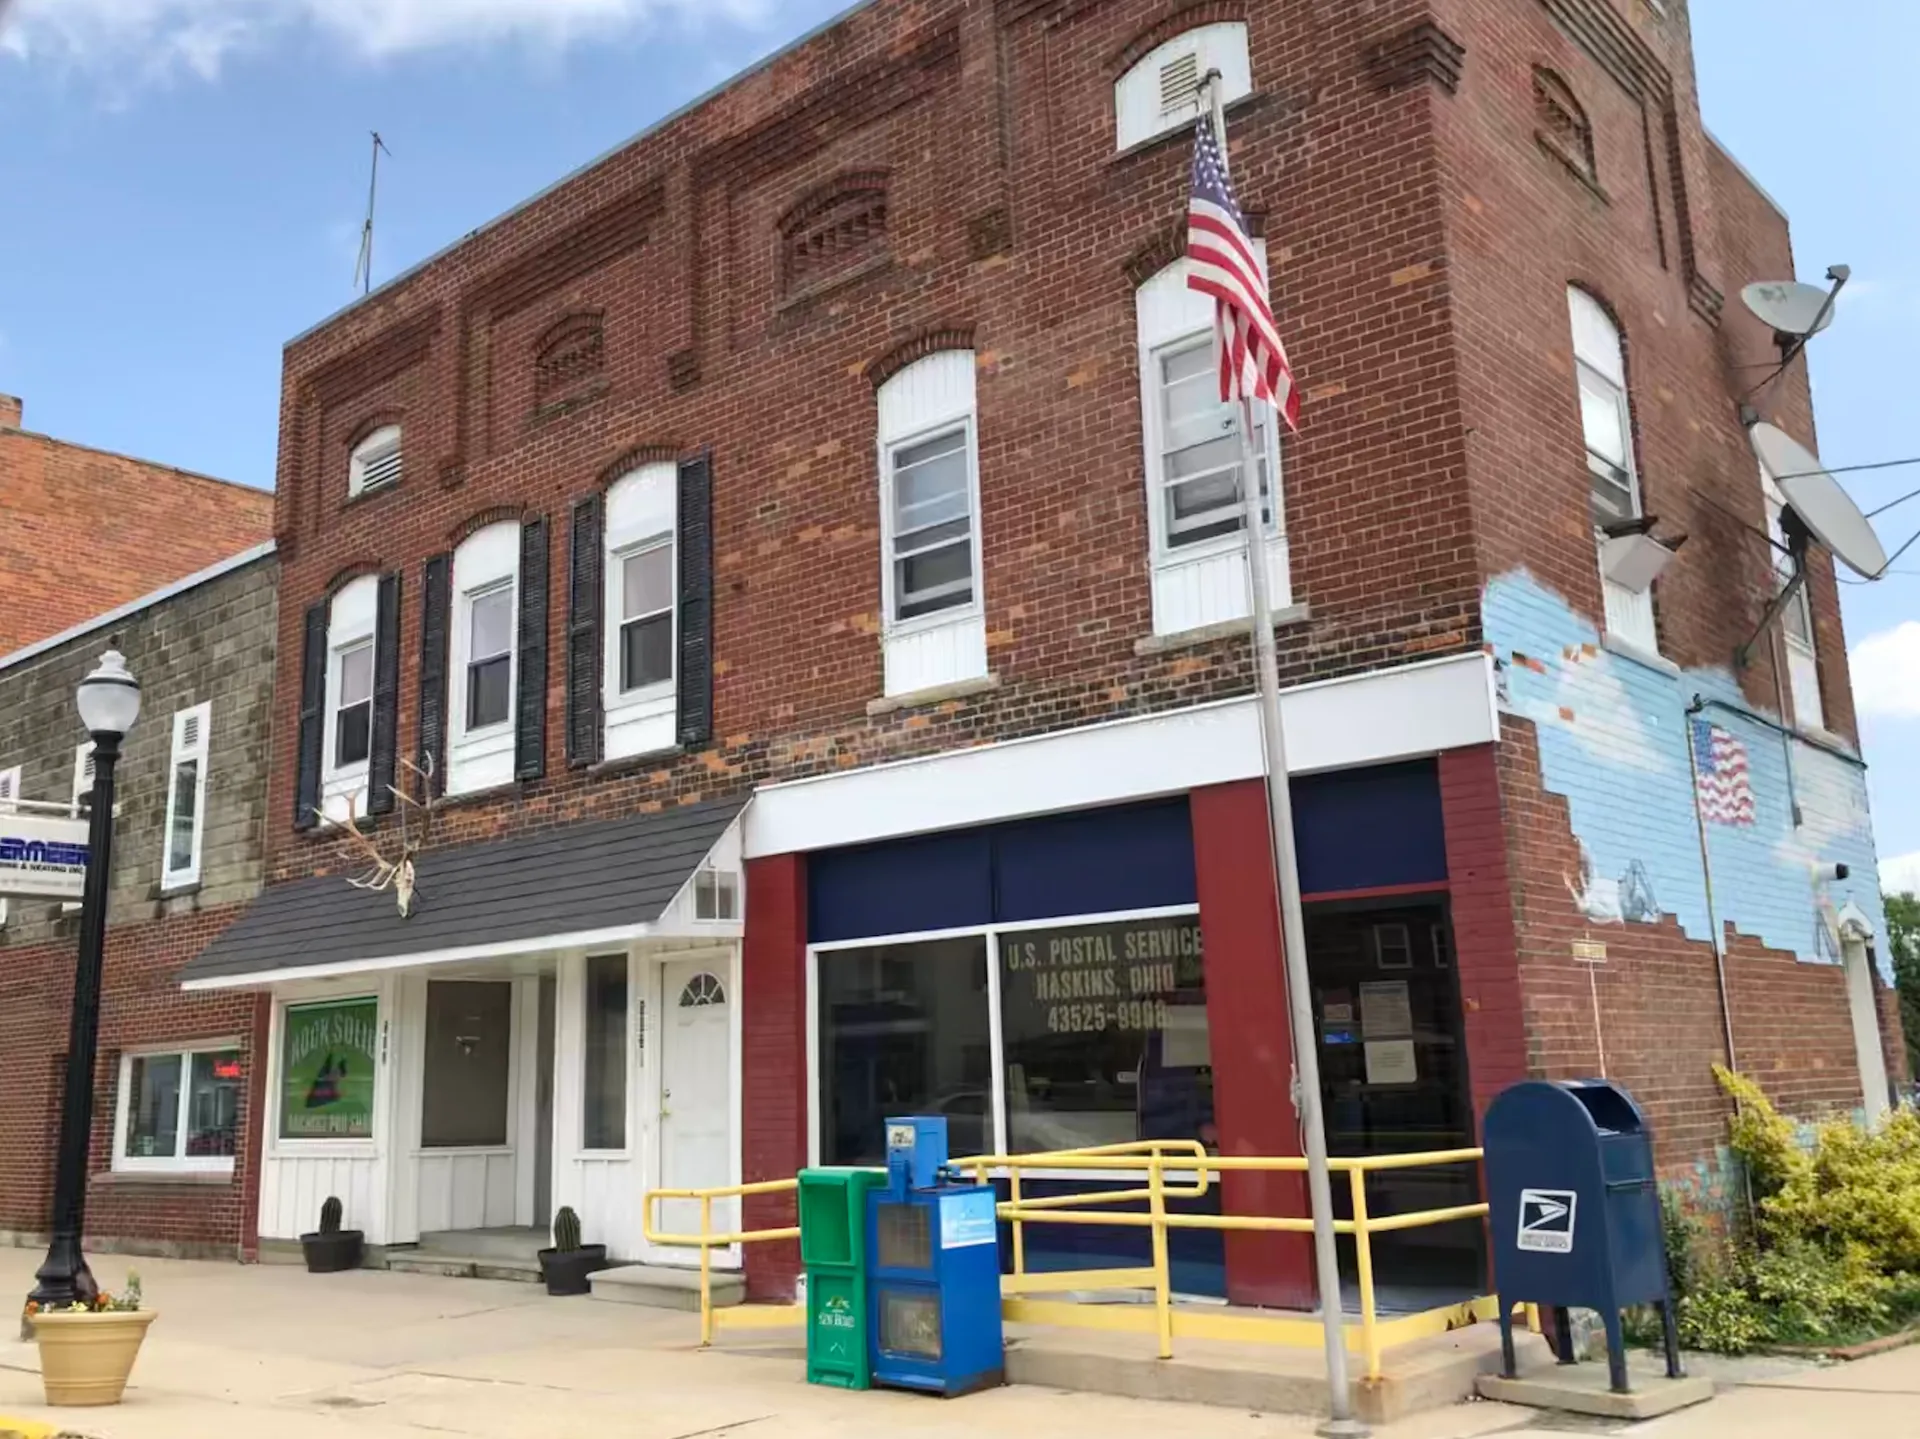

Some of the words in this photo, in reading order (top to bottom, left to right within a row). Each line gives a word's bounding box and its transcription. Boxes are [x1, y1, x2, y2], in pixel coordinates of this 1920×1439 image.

[1007, 941, 1042, 972] U.S.
[1050, 933, 1117, 965] POSTAL
[1124, 925, 1204, 960] SERVICE
[1129, 963, 1176, 996] OHIO
